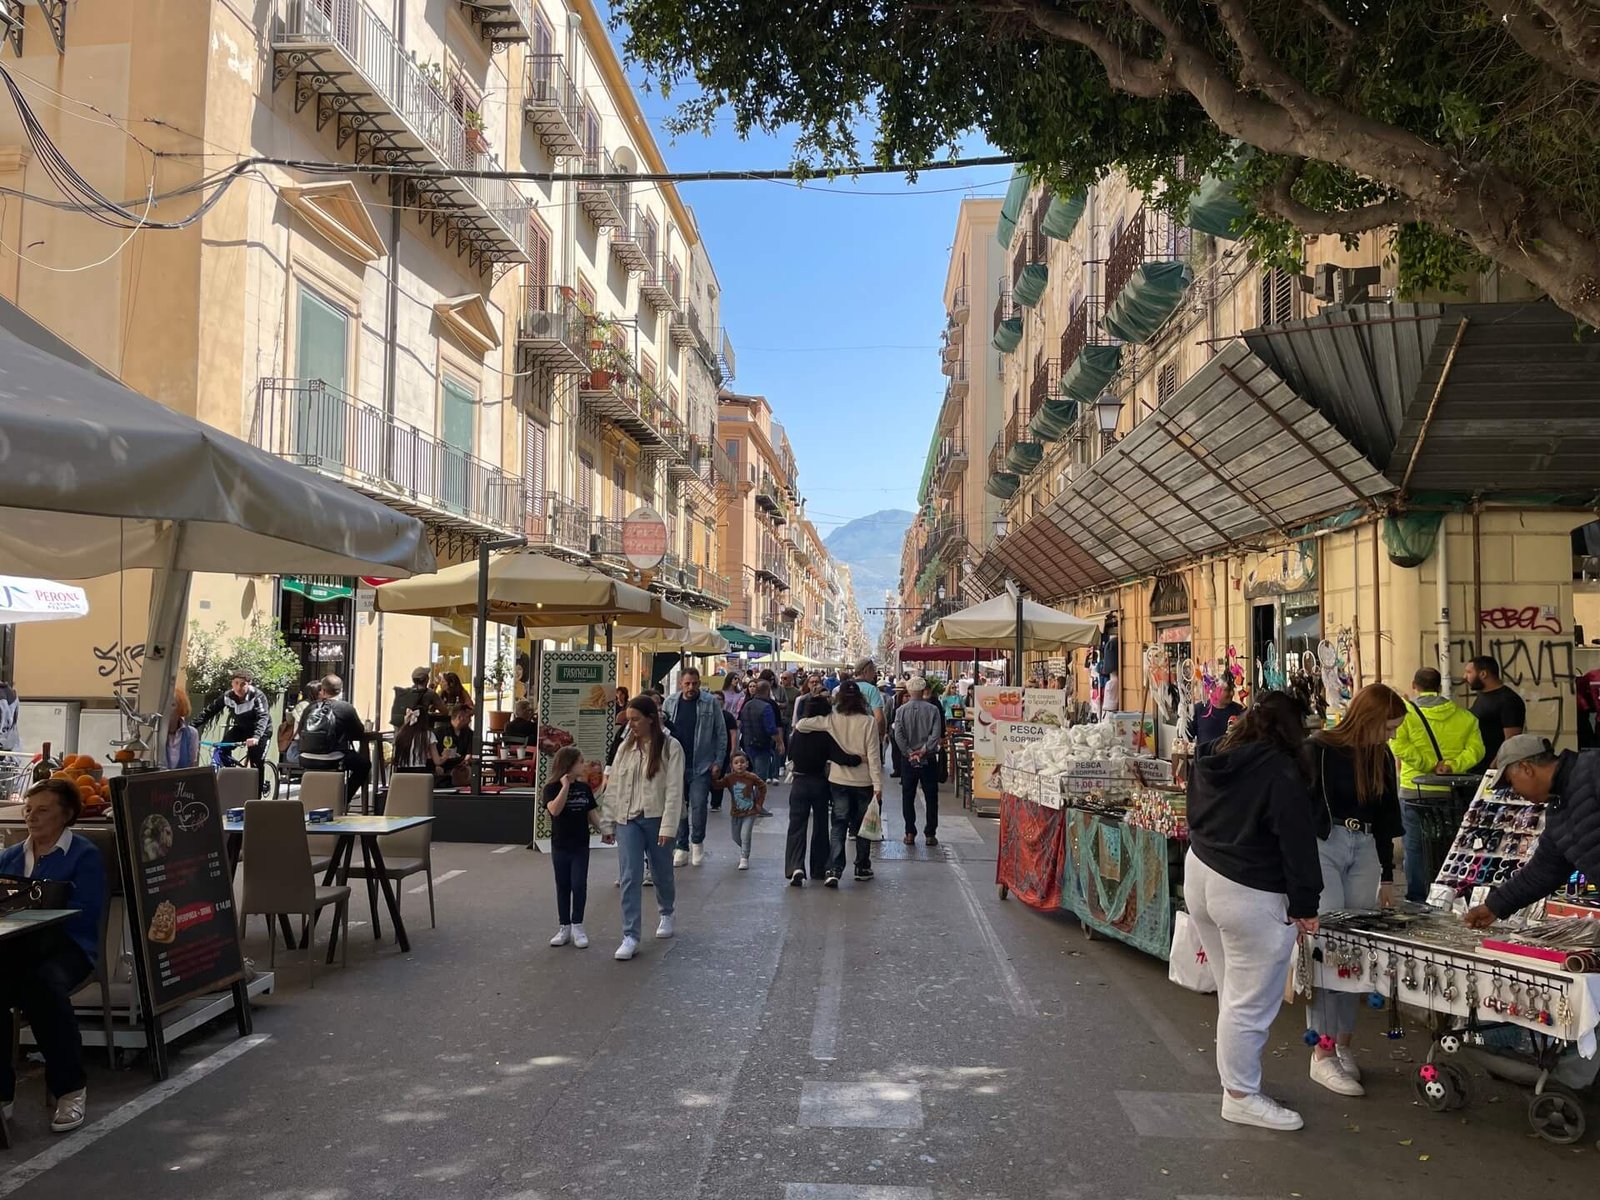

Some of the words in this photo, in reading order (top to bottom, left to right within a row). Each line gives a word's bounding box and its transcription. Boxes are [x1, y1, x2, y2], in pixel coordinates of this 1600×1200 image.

[1010, 725, 1044, 735] PESCA
[1075, 761, 1102, 769] PESCA
[1134, 761, 1159, 771] PESCA
